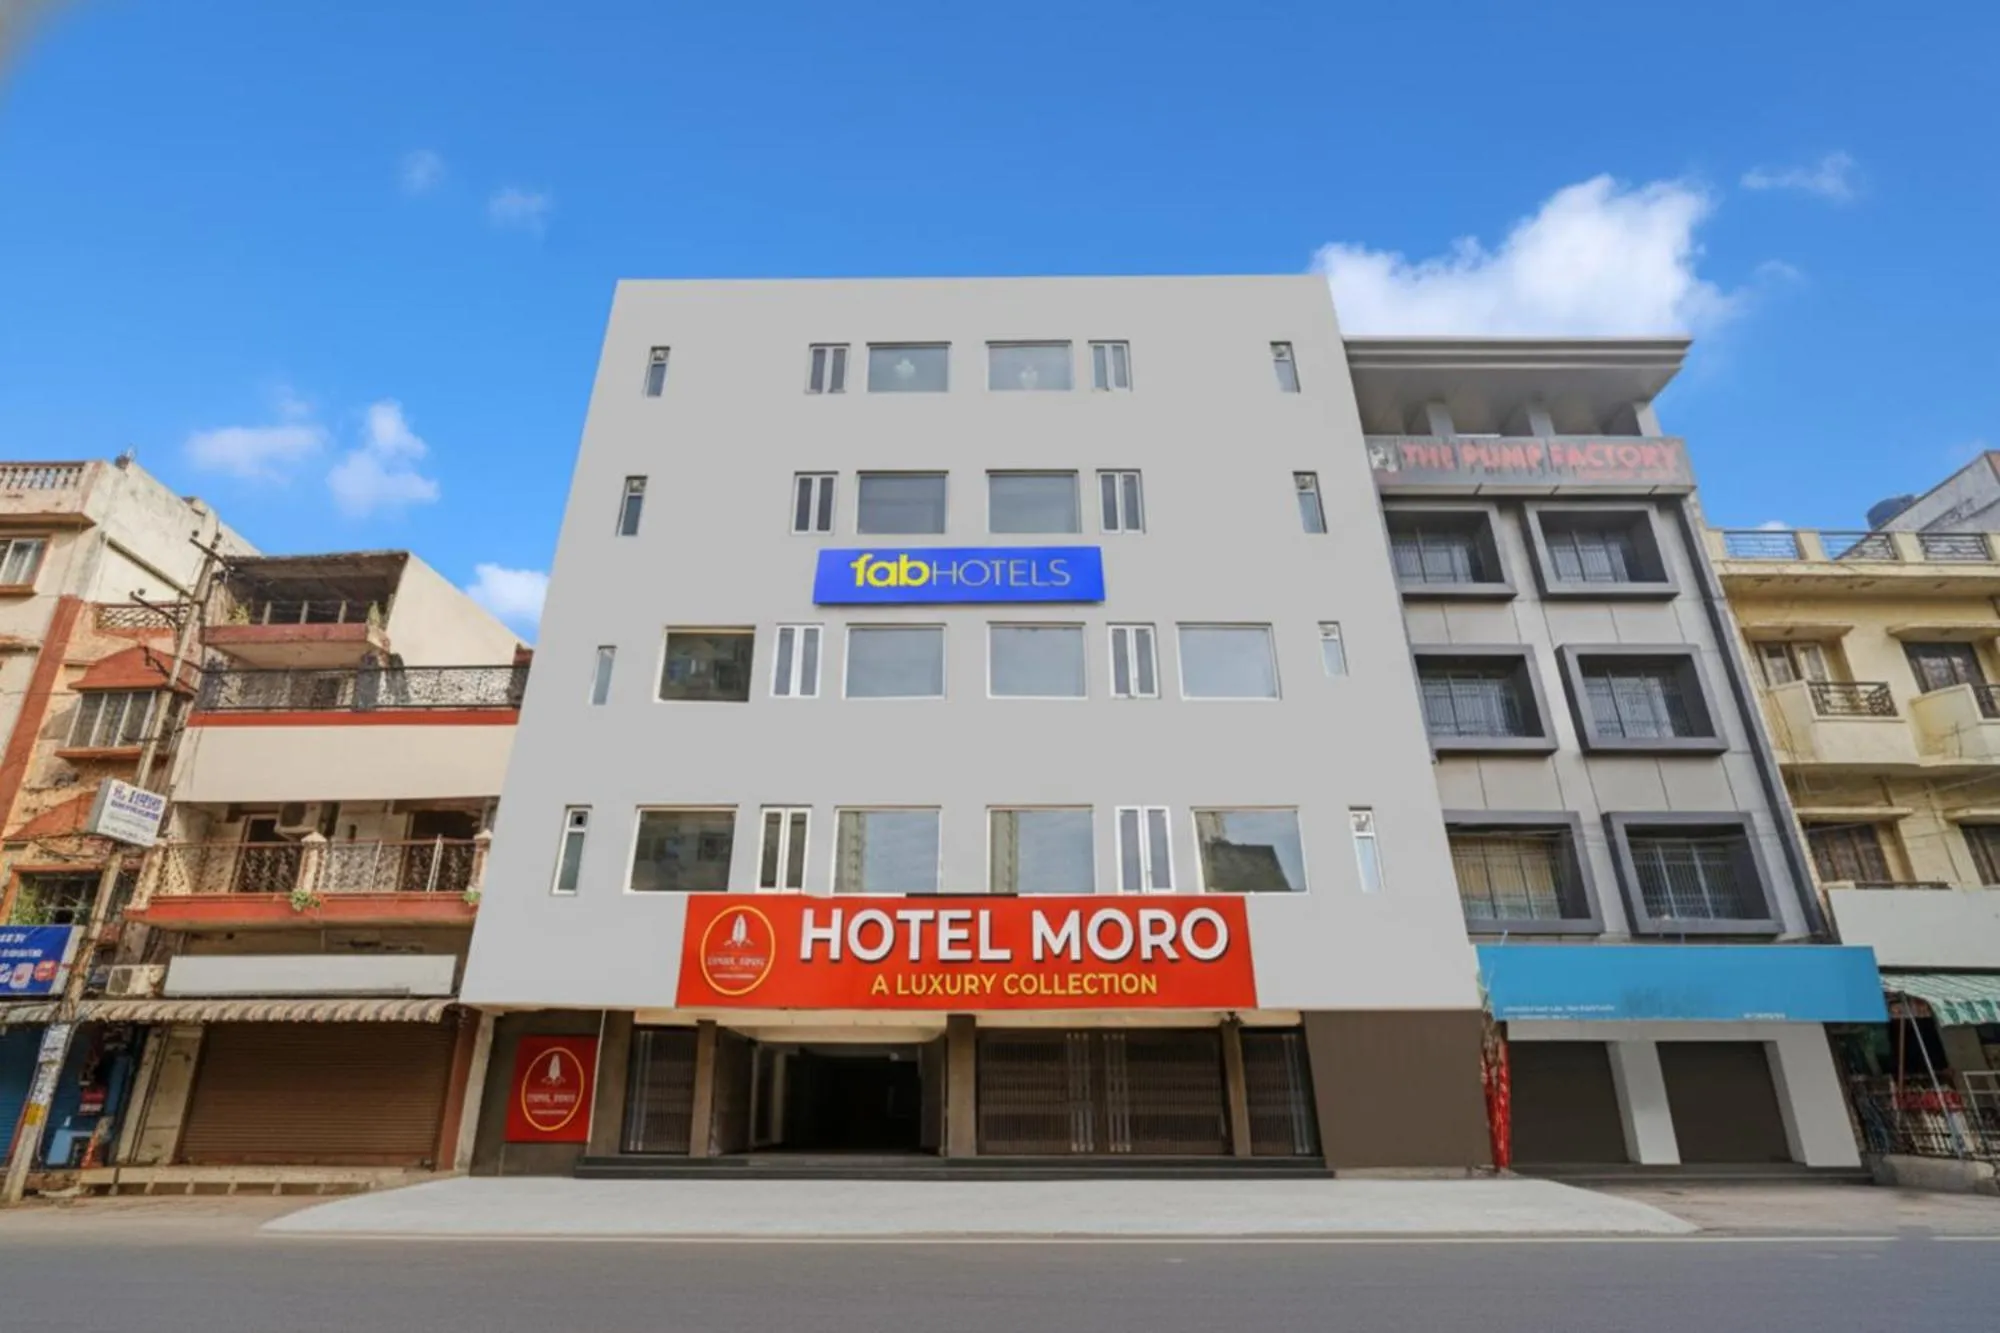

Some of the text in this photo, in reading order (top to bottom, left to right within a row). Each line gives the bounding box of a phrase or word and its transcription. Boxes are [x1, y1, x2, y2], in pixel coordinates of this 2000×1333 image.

[1402, 442, 1682, 472] THE PUMP FACTORY
[800, 907, 1229, 961] HOTEL MORO
[871, 973, 1157, 995] A LUXURY COLLECTION
